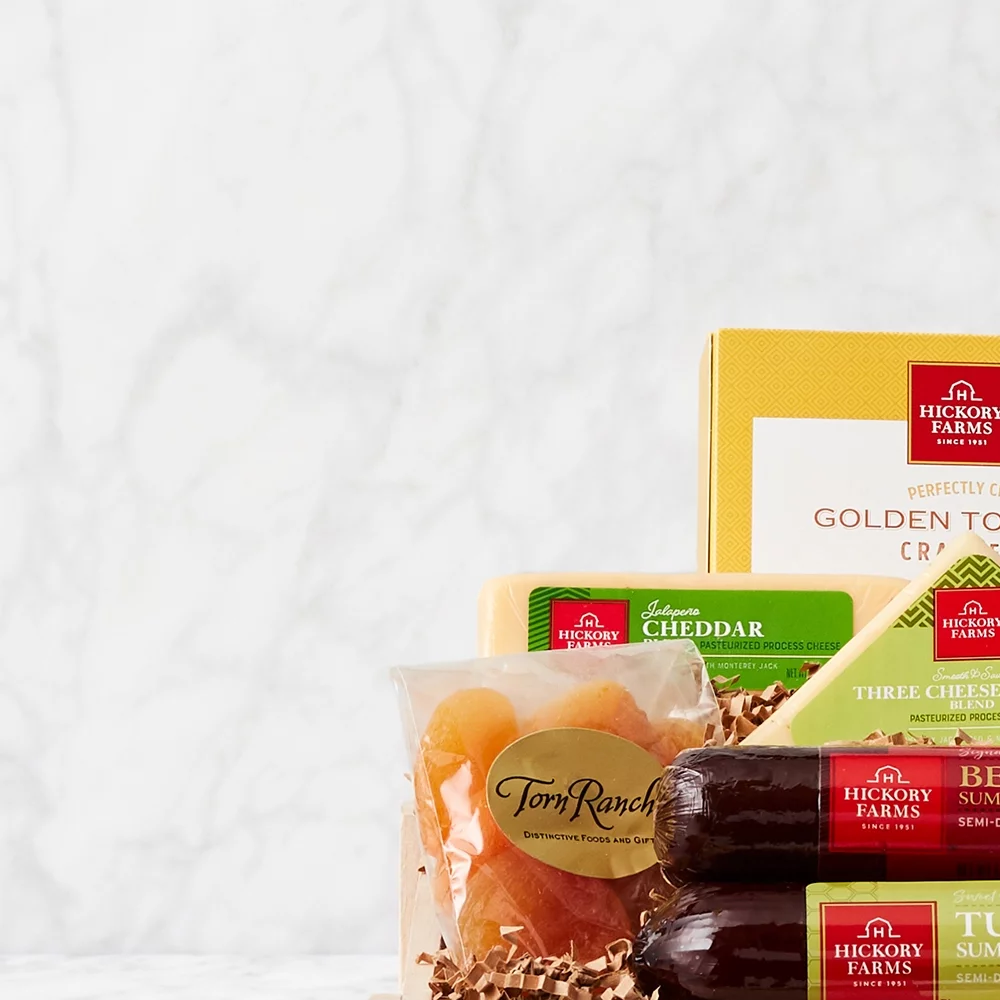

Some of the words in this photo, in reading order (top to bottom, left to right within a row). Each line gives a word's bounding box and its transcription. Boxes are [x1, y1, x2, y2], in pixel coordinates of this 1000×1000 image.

[931, 421, 993, 435] FARMS
[907, 480, 986, 500] PERFECTLY
[814, 507, 950, 530] GOLDEN
[558, 630, 620, 641] HICKORY
[642, 620, 765, 638] CHEDDAR
[951, 628, 996, 639] FARMS
[700, 641, 761, 651] PASTEURIZED
[763, 641, 804, 651] PROCESS
[806, 642, 841, 651] CHEESE
[758, 662, 778, 670] JACK
[853, 684, 921, 700] THREE
[950, 699, 995, 710] BLEND
[910, 713, 967, 723] PASTEURIZED
[844, 787, 933, 802] HICKORY
[856, 803, 921, 818] FARMS
[834, 943, 924, 958] HICKORY
[847, 961, 912, 975] FARMS
